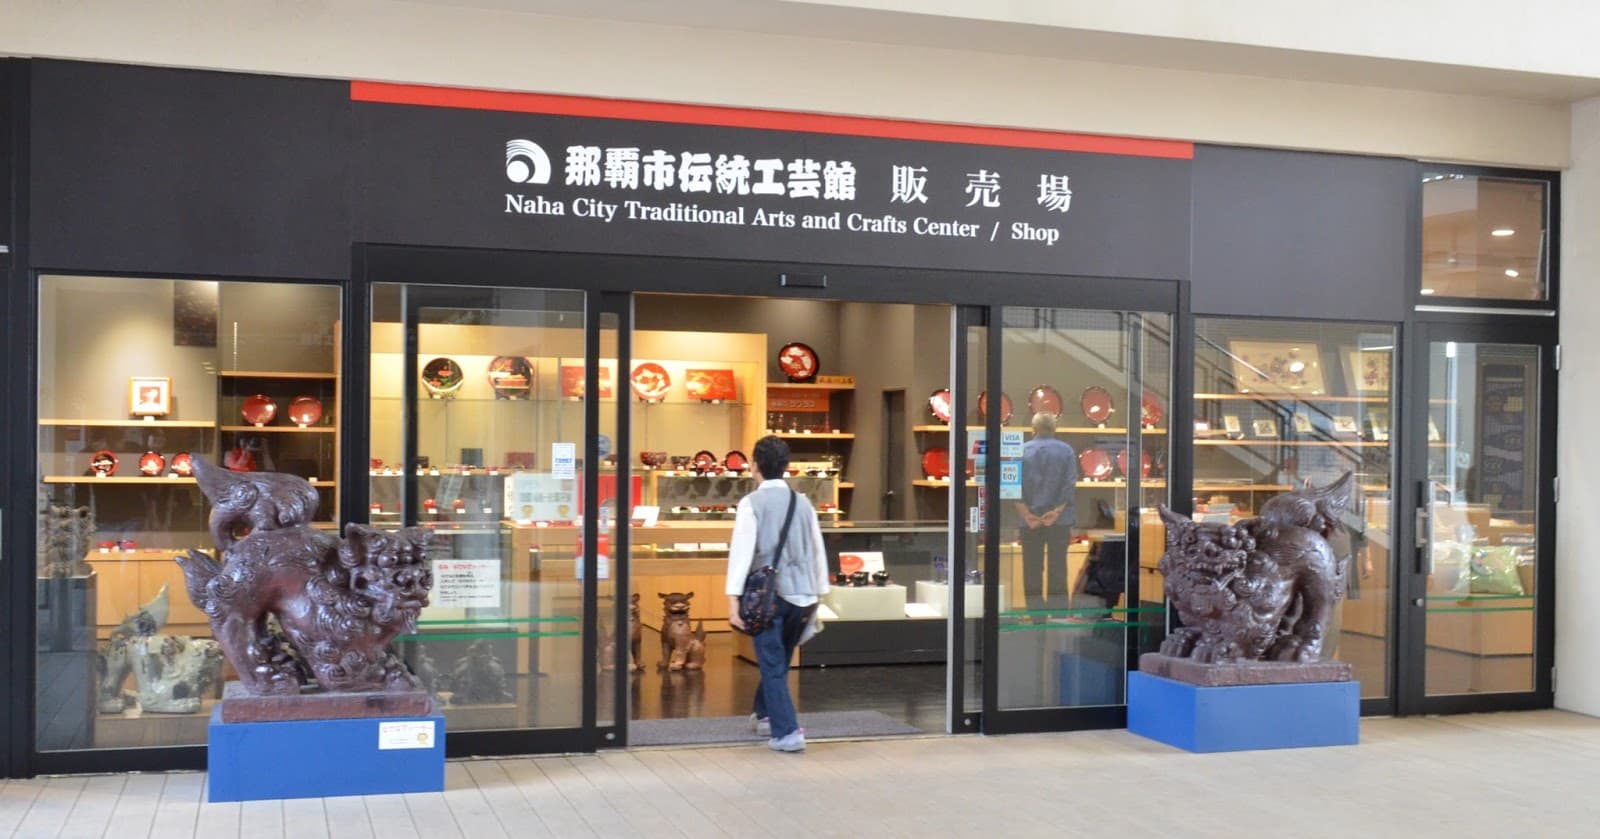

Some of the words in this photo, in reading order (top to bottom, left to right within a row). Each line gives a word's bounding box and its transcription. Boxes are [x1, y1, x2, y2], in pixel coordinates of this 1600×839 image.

[565, 144, 857, 201] 那覇市伝統工芸館
[504, 193, 565, 216] Naha
[572, 196, 618, 223] City
[624, 200, 746, 225] Traditional
[752, 207, 796, 228] Arts
[802, 210, 841, 231] and
[847, 212, 908, 234] Crafts
[913, 217, 981, 238] Center
[989, 220, 1000, 242] /
[1011, 221, 1060, 247] Shop
